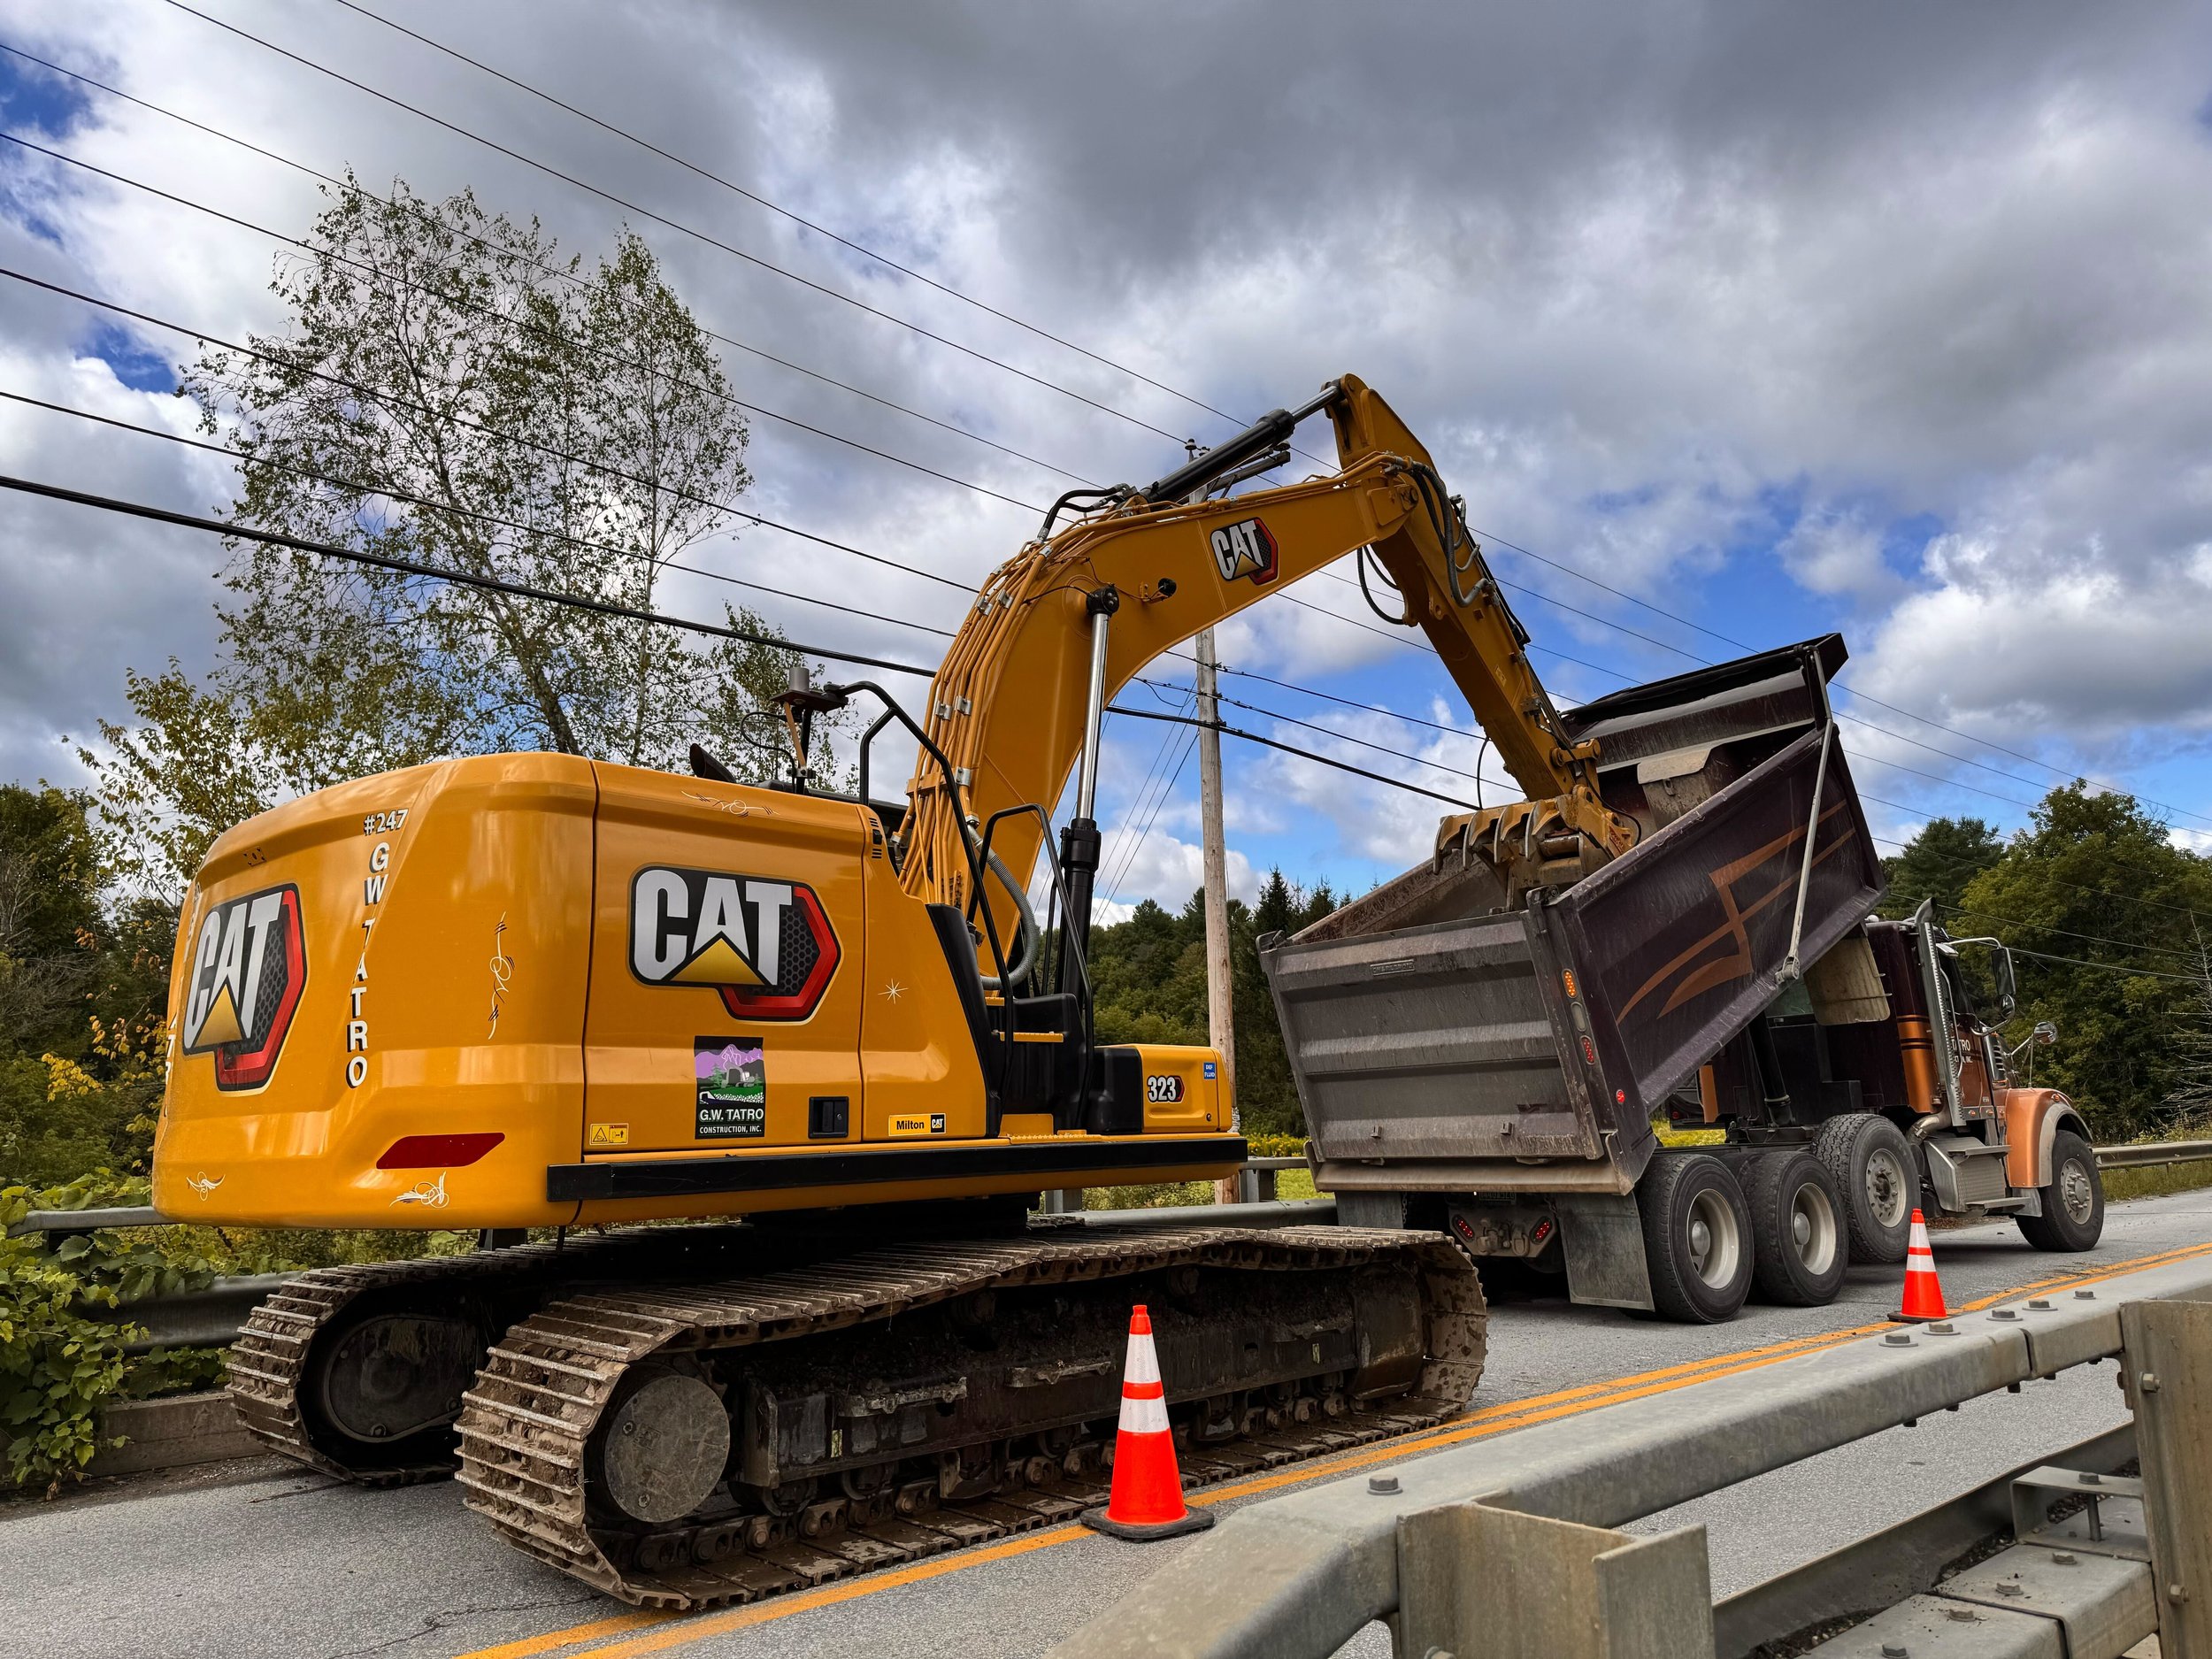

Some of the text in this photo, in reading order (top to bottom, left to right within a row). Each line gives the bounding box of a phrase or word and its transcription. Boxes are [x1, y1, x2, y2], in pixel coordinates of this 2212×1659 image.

[1211, 519, 1263, 580] CAT
[364, 808, 409, 836] #247
[634, 869, 792, 986] CAT
[183, 891, 283, 1049] CAT
[1148, 1076, 1176, 1101] 323
[699, 1108, 764, 1121] G.W. TATRO
[895, 1119, 925, 1131] Milton
[931, 1118, 944, 1129] CAT
